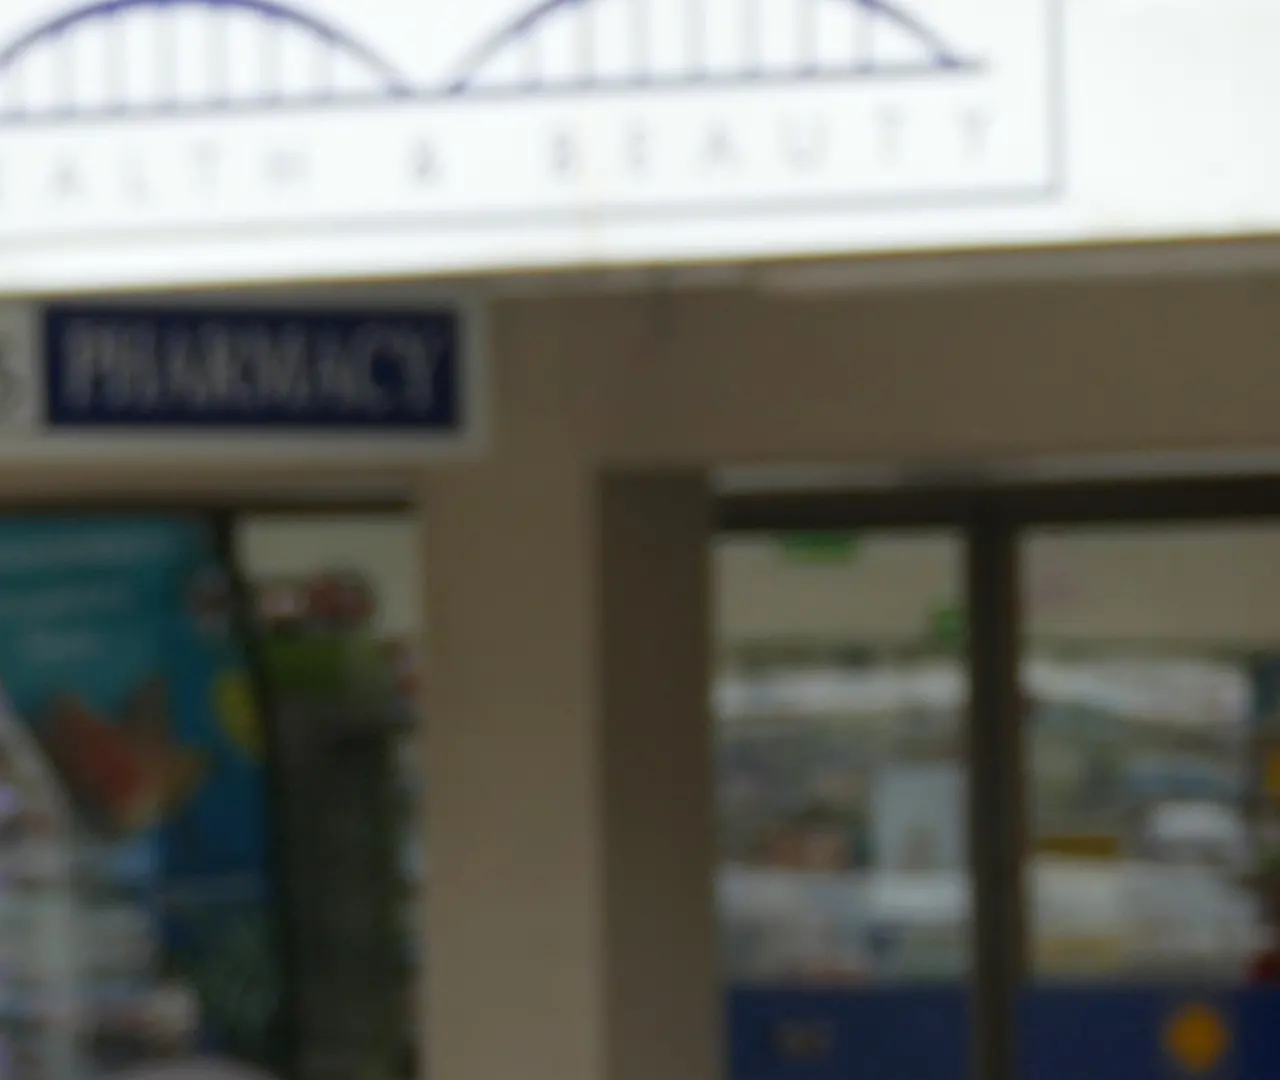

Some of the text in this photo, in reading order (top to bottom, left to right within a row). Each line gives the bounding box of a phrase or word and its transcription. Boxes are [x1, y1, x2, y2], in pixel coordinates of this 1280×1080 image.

[407, 128, 444, 191] &
[546, 106, 995, 185] BEAUTY
[65, 318, 444, 412] PHARMACY
